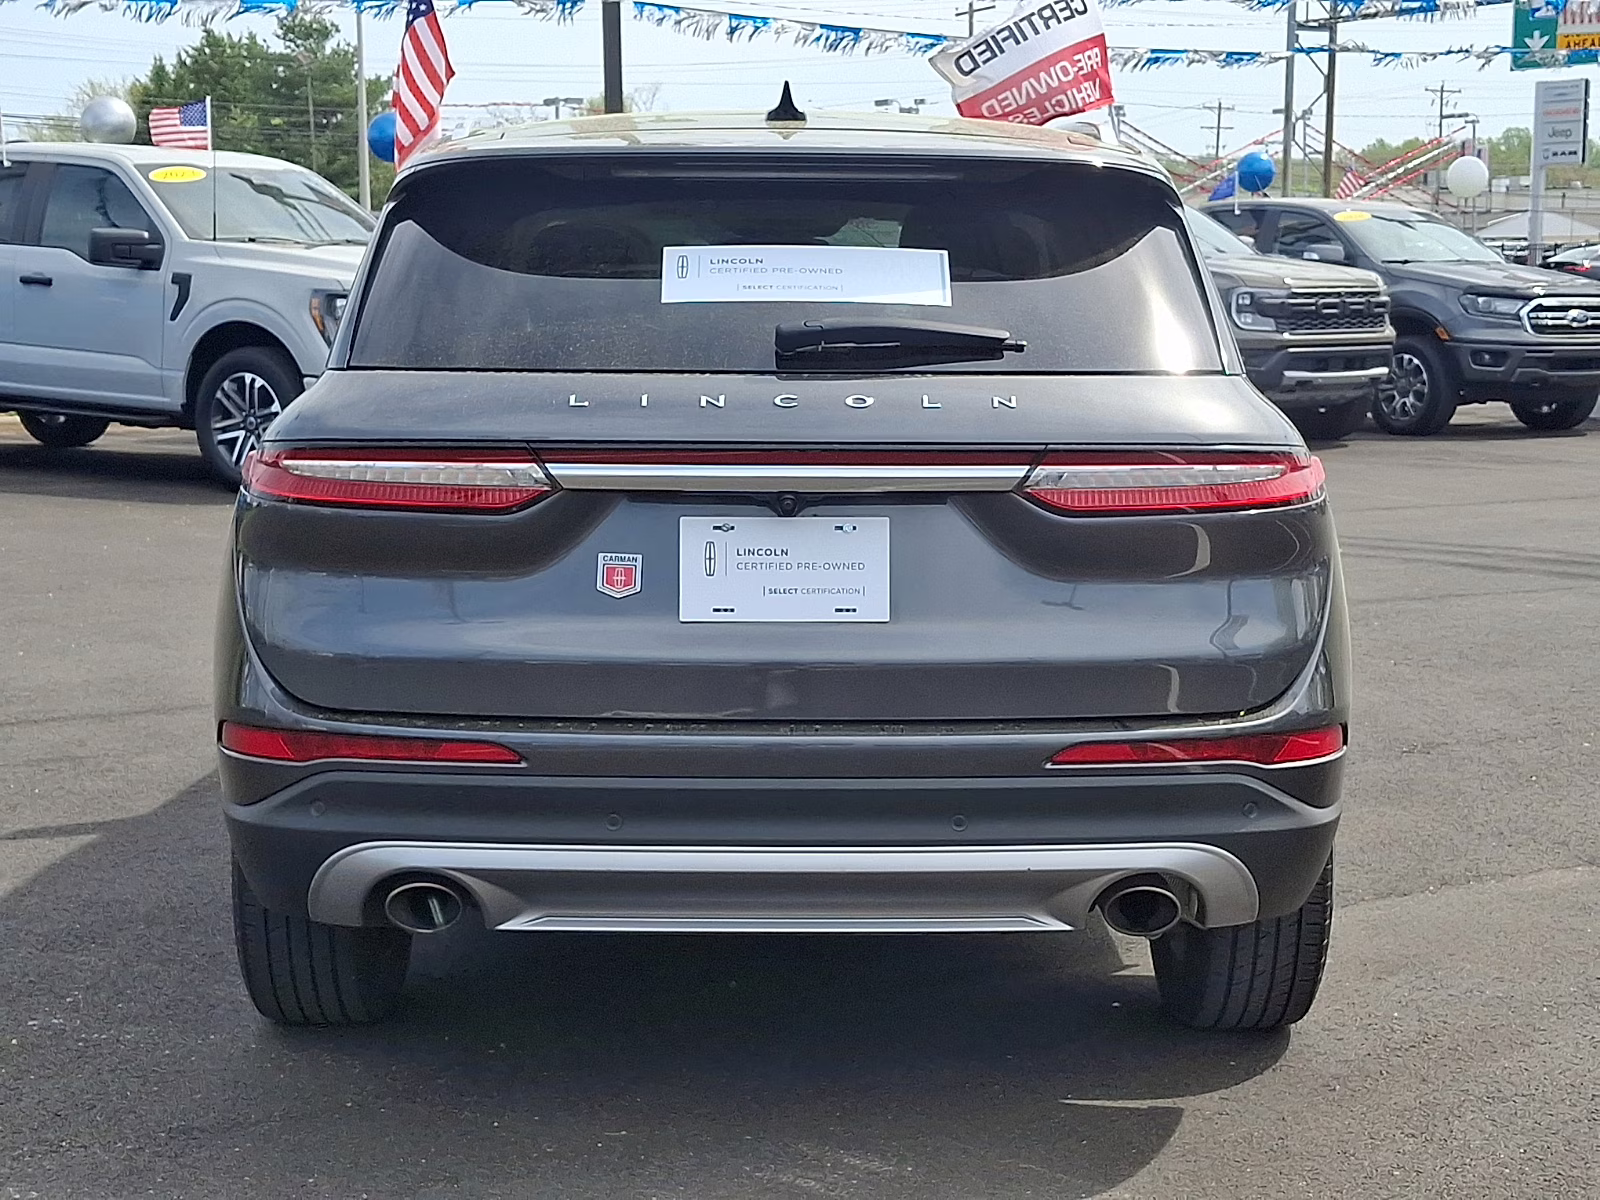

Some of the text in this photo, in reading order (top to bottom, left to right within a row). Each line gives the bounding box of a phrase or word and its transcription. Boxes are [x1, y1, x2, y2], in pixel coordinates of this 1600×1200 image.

[1565, 38, 1600, 49] AHEA
[1547, 127, 1573, 140] Jeep
[1551, 149, 1578, 158] RAM
[709, 267, 844, 275] CERTIFIED PRE-OWNED
[775, 284, 839, 292] CERTIFICATION
[568, 393, 1018, 409] LINCOLN
[736, 547, 790, 557] LINCOLN
[602, 554, 638, 564] CARMAN
[736, 561, 866, 571] CERTIFIED PRE-OWNED
[767, 587, 861, 595] SELECT CERTIFICATION
